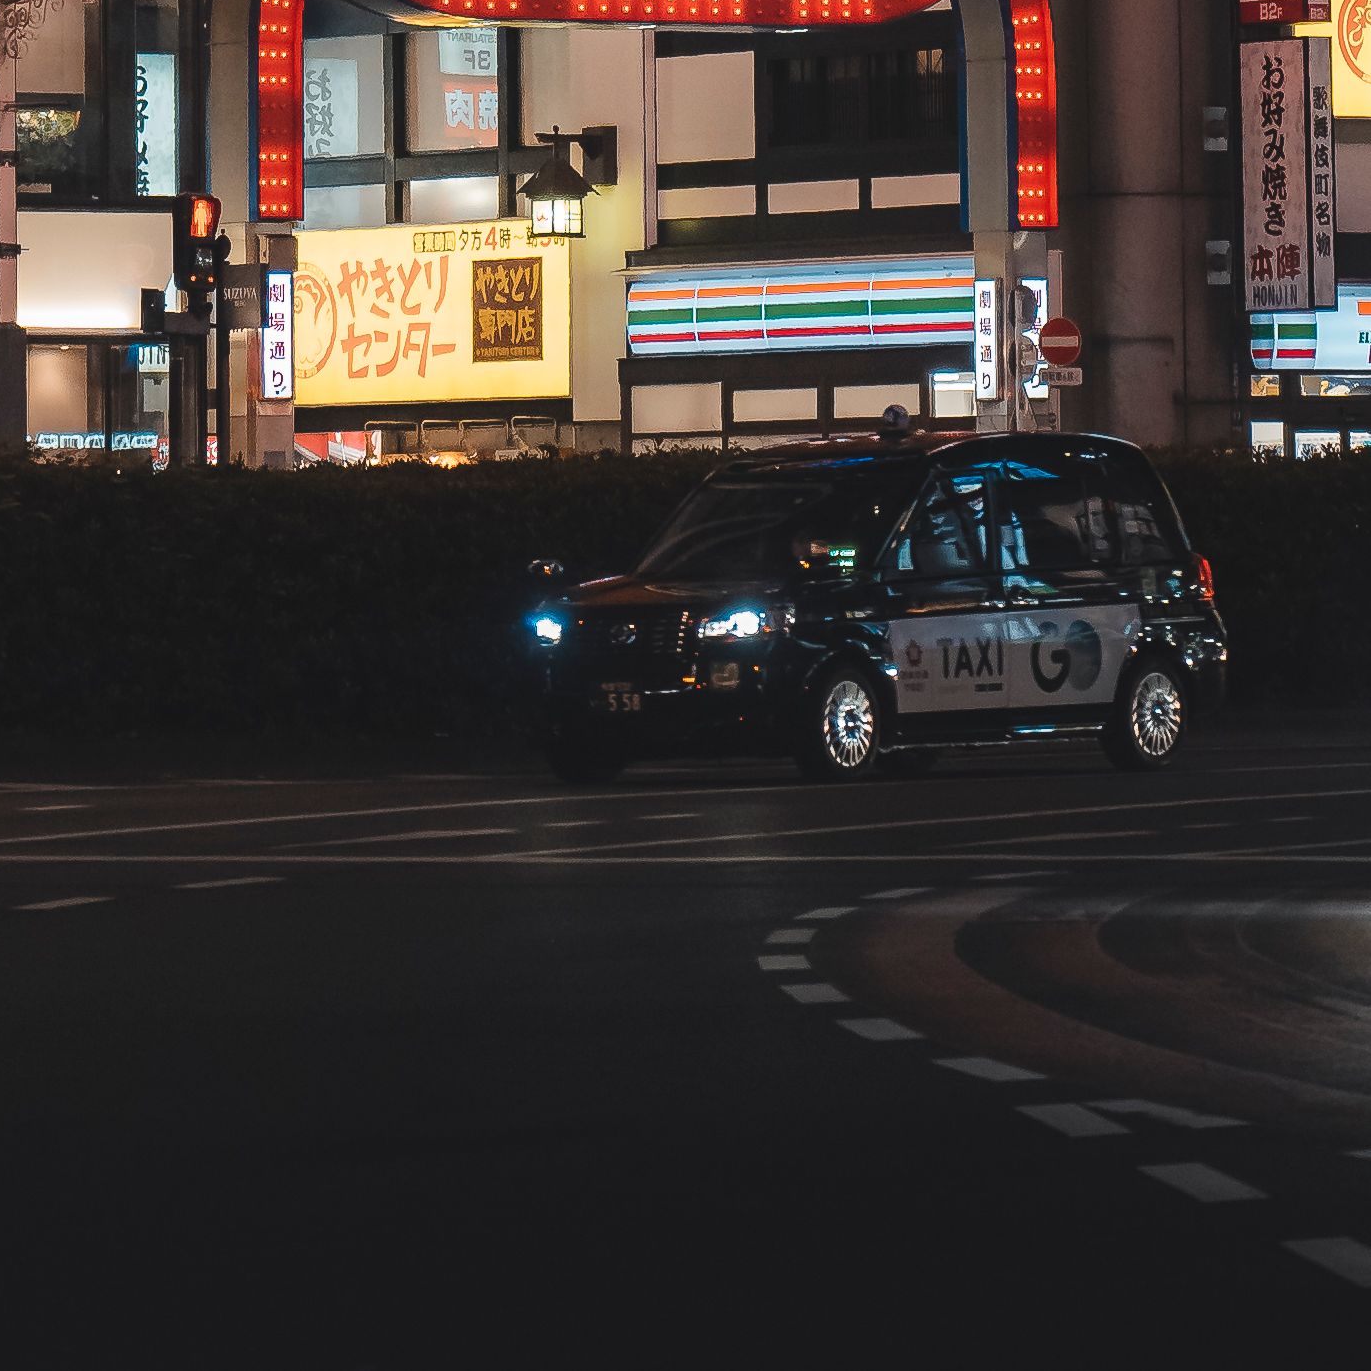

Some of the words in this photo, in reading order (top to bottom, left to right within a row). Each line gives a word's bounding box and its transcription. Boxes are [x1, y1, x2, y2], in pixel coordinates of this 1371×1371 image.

[1260, 2, 1283, 21] B2F
[1259, 54, 1288, 238] お好み焼き
[1312, 85, 1331, 260] 歌舞伎町名物
[475, 262, 540, 305] やきとり
[1250, 244, 1302, 283] 本陣
[223, 287, 257, 300] SUZUYA
[337, 255, 450, 319] やきとり
[1252, 284, 1298, 307] HONJIN
[268, 283, 286, 388] 劇場通り
[478, 305, 537, 346] 専門店
[979, 290, 992, 389] 劇場通り
[139, 345, 170, 365] JIN
[341, 322, 457, 379] センター
[936, 637, 1004, 680] TAXI
[1031, 619, 1103, 694] GO
